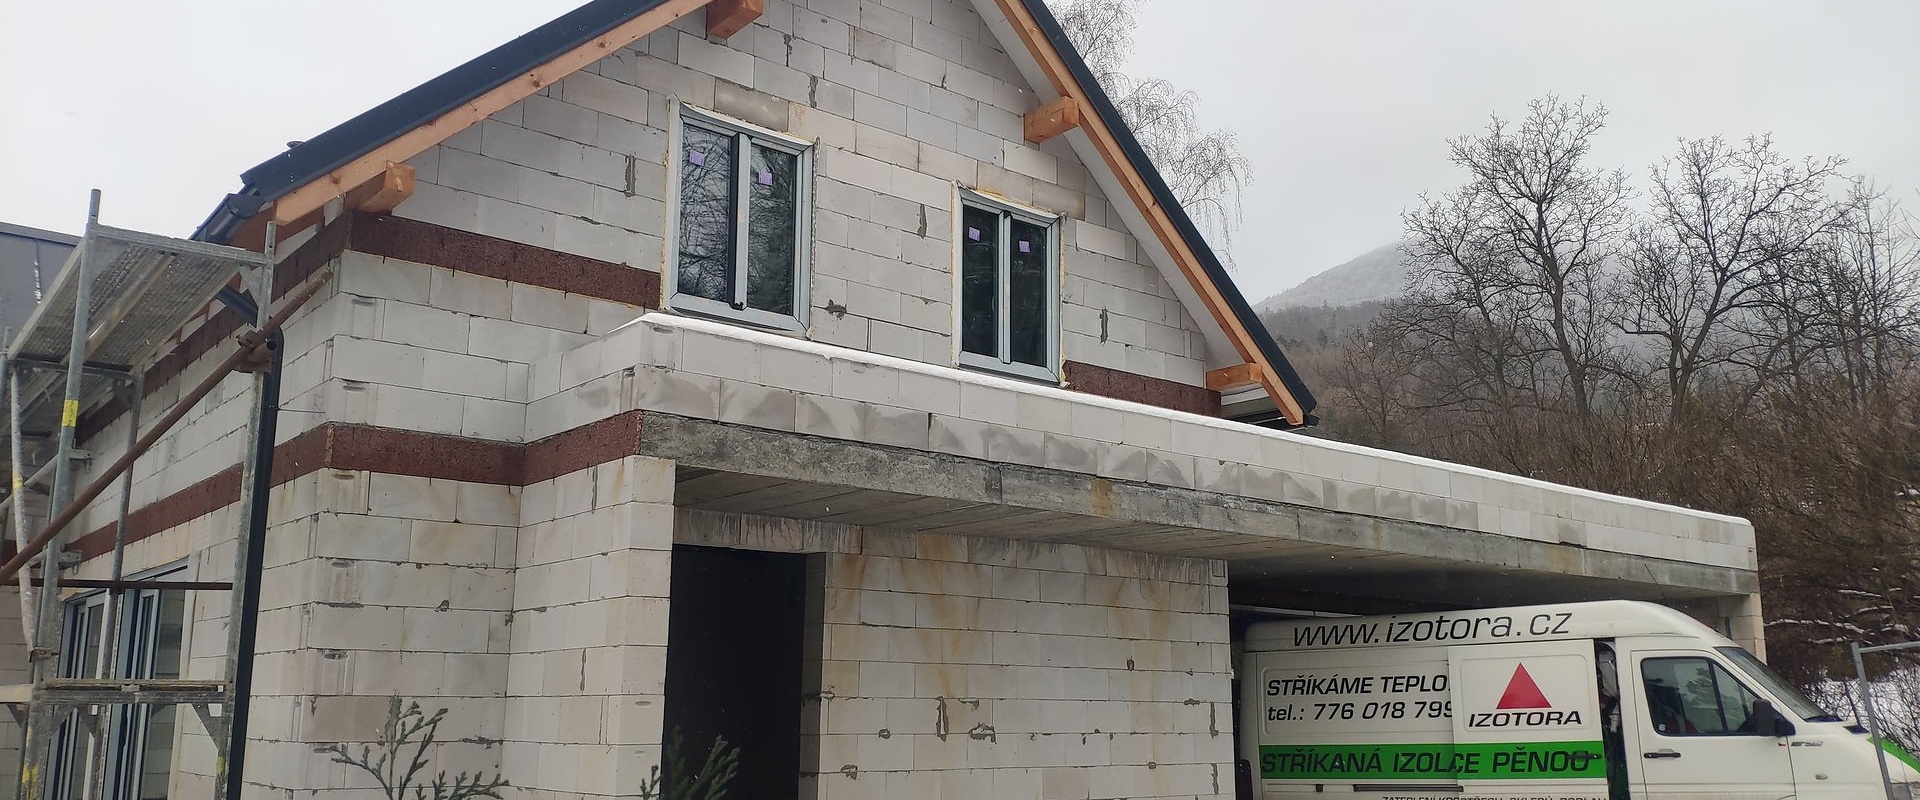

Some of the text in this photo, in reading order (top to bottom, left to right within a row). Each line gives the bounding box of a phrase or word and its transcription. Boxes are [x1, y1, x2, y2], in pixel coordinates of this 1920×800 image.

[1293, 612, 1573, 646] www.izotora.cz
[1267, 673, 1450, 696] STŘÍKÁME TEPLO
[1267, 703, 1305, 721] tel.:
[1313, 702, 1354, 720] 776
[1361, 701, 1405, 719] 018
[1468, 710, 1583, 728] IZOTORA
[1261, 747, 1383, 773] STŘÍKANÁ
